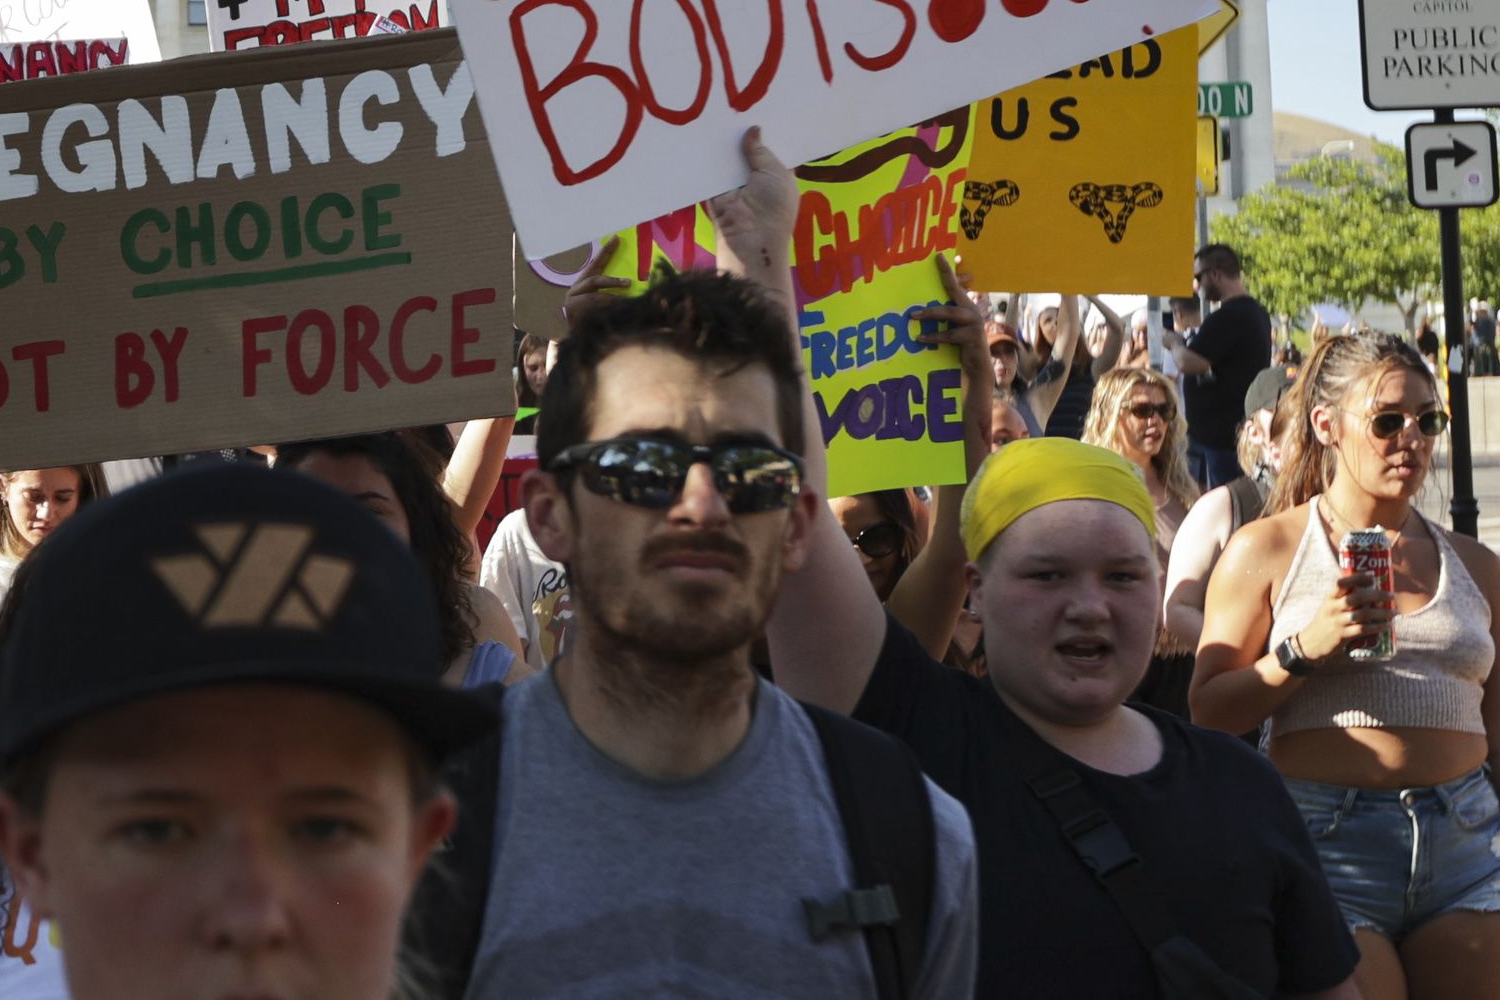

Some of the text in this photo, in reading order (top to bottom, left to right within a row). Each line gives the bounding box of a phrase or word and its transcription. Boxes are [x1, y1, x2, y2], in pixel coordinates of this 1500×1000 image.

[1393, 25, 1498, 51] PUBLIC
[1413, 0, 1474, 14] CAPITOL
[1234, 84, 1249, 116] N
[120, 183, 401, 275] CHOICE
[792, 167, 968, 298] CHOICE
[115, 326, 189, 410] BY
[241, 287, 496, 399] FORCE
[812, 368, 966, 449] VOICE
